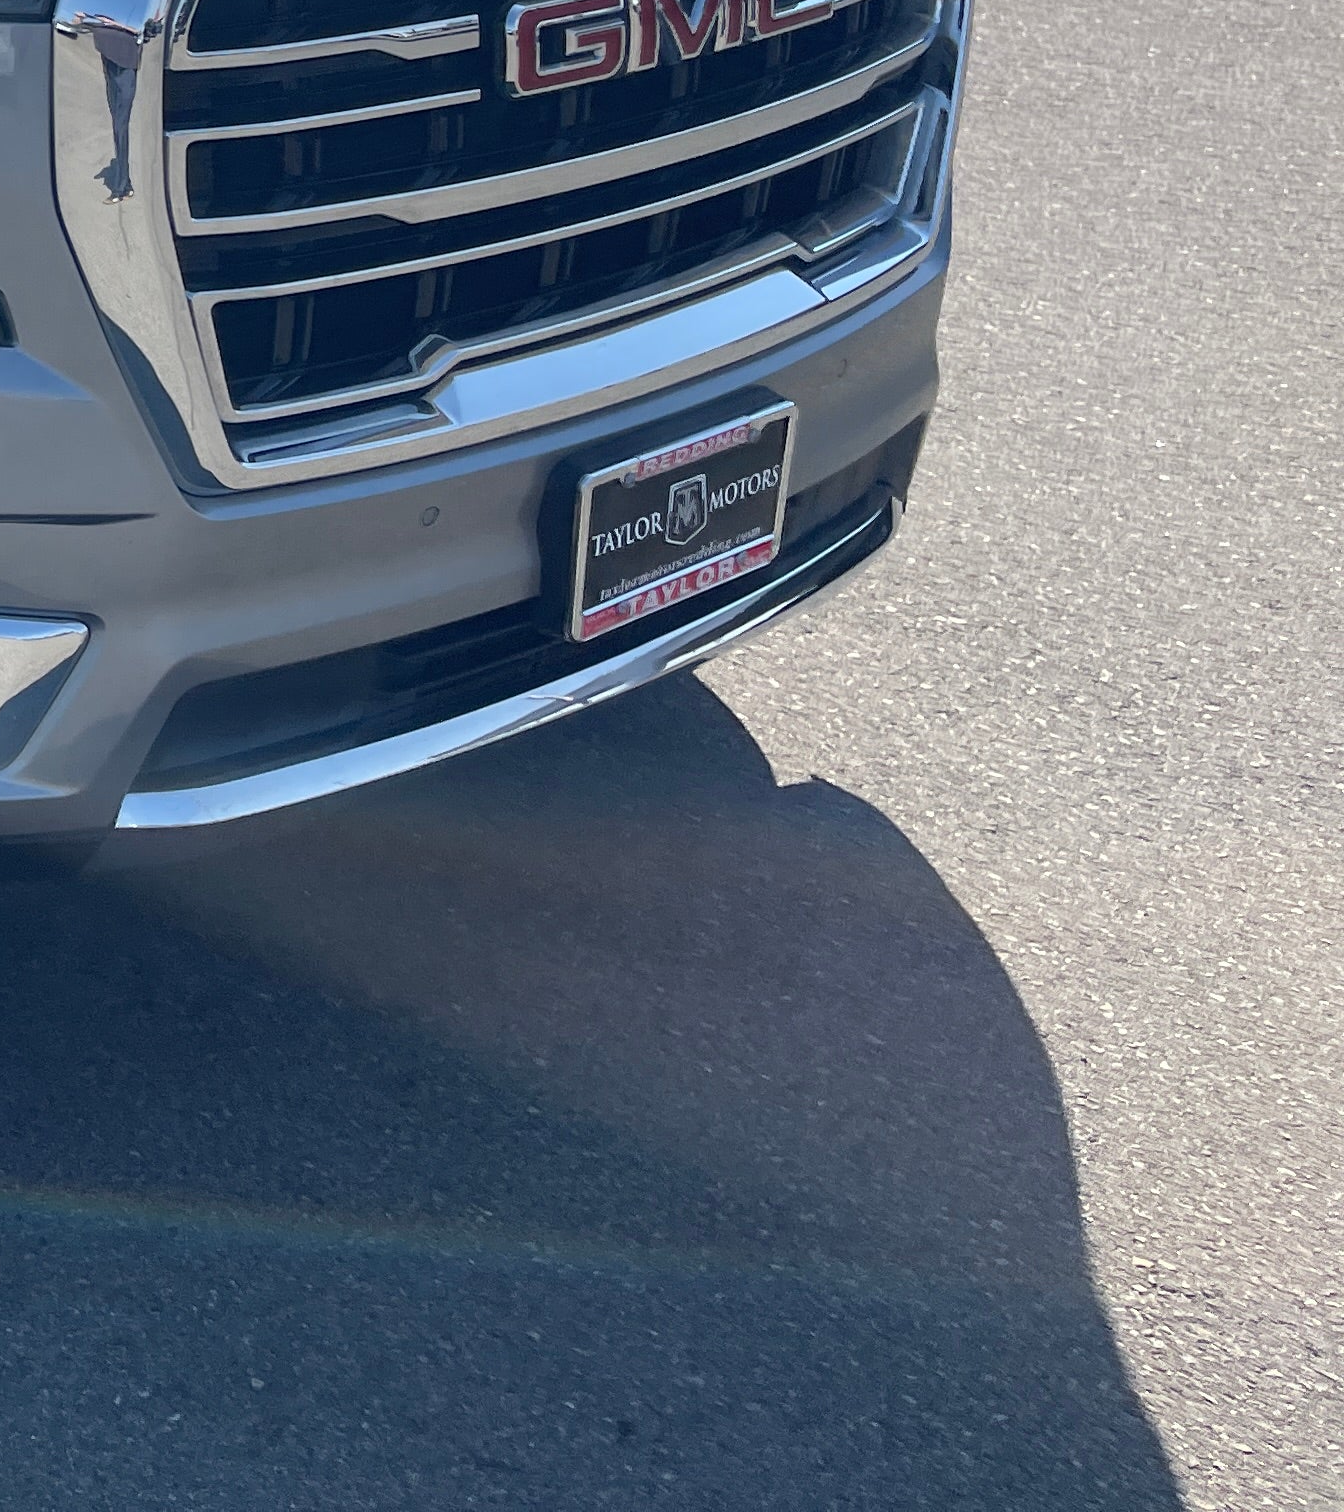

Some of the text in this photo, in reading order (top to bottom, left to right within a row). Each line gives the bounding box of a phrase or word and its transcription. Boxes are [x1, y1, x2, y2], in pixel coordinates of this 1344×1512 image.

[641, 425, 750, 476] REDDING
[591, 512, 664, 557] TAYLOR
[707, 464, 781, 513] MOTORS
[627, 556, 736, 619] TAYLOR
